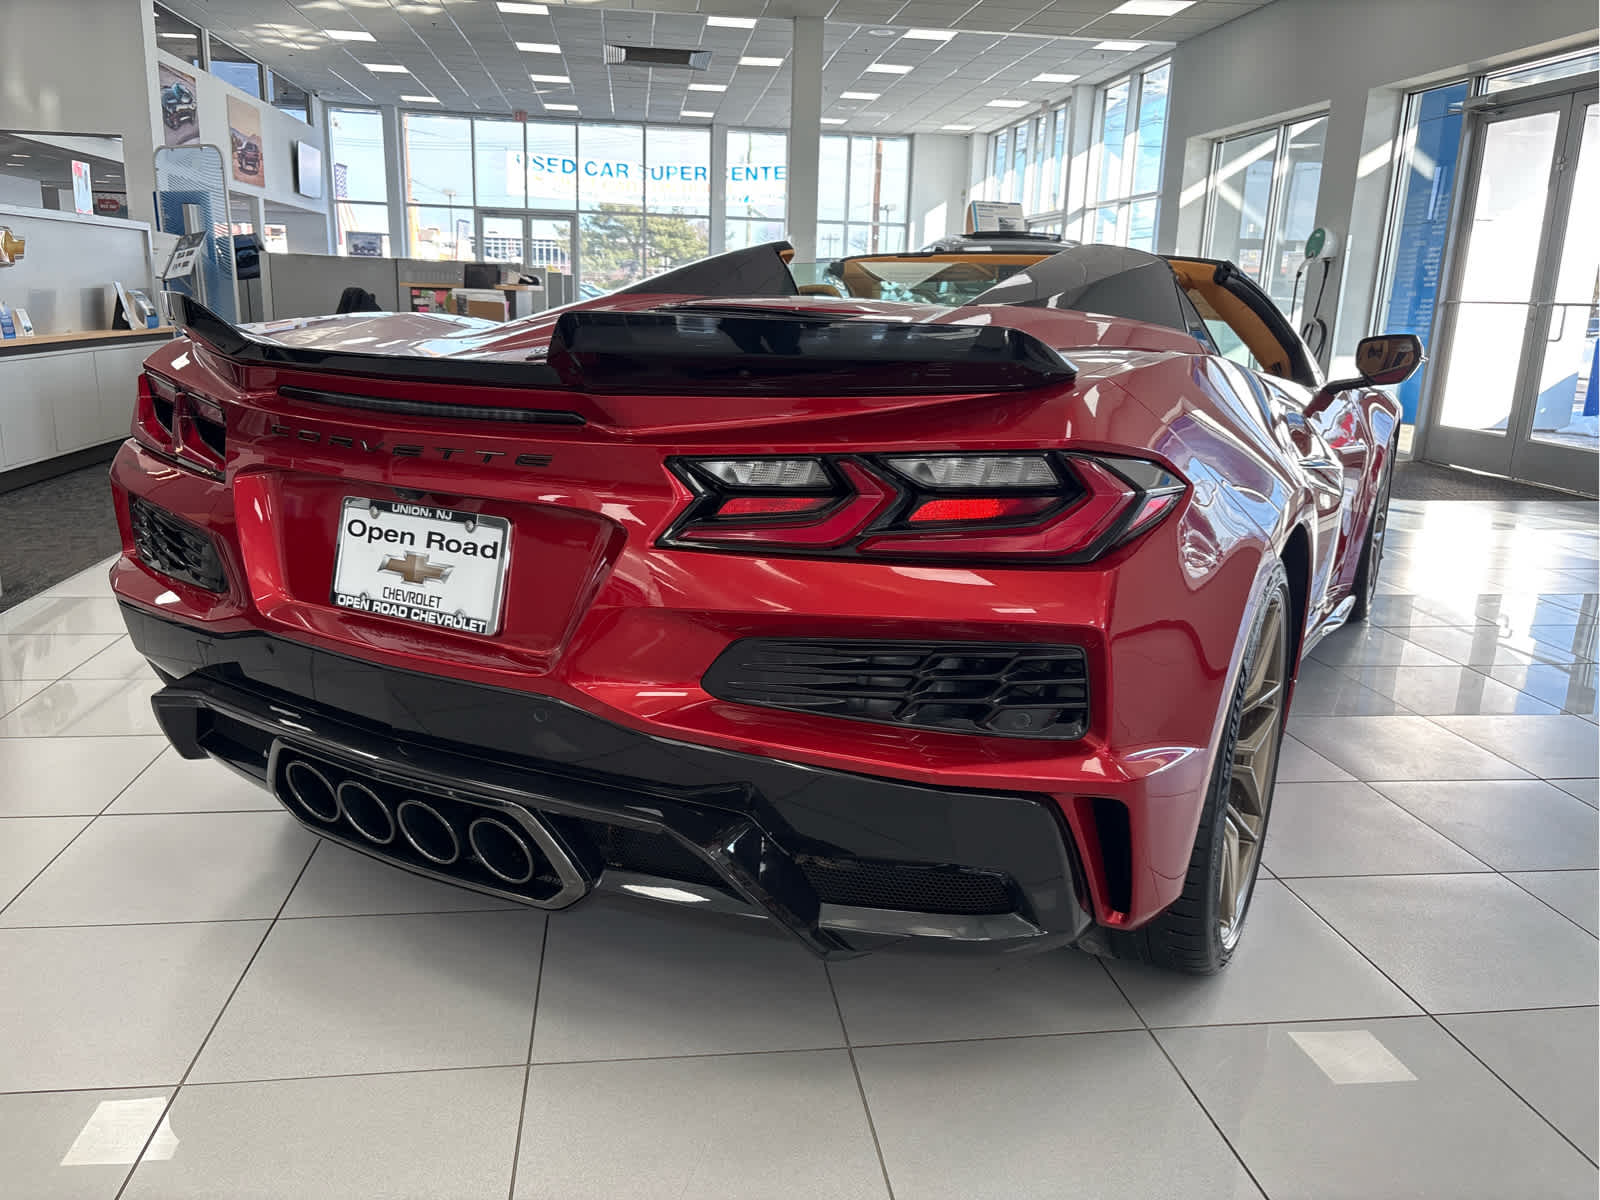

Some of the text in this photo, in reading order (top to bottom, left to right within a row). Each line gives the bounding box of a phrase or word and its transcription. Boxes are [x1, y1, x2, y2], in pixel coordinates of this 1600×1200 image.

[516, 153, 577, 174] SED
[584, 160, 629, 178] CAR
[639, 163, 707, 181] UPER
[271, 424, 553, 467] CORVETTE
[435, 509, 452, 521] NJ
[347, 519, 499, 560] Open Road
[337, 594, 486, 634] OPEN ROAD CHEVROLET
[382, 586, 443, 609] CHEVROLET
